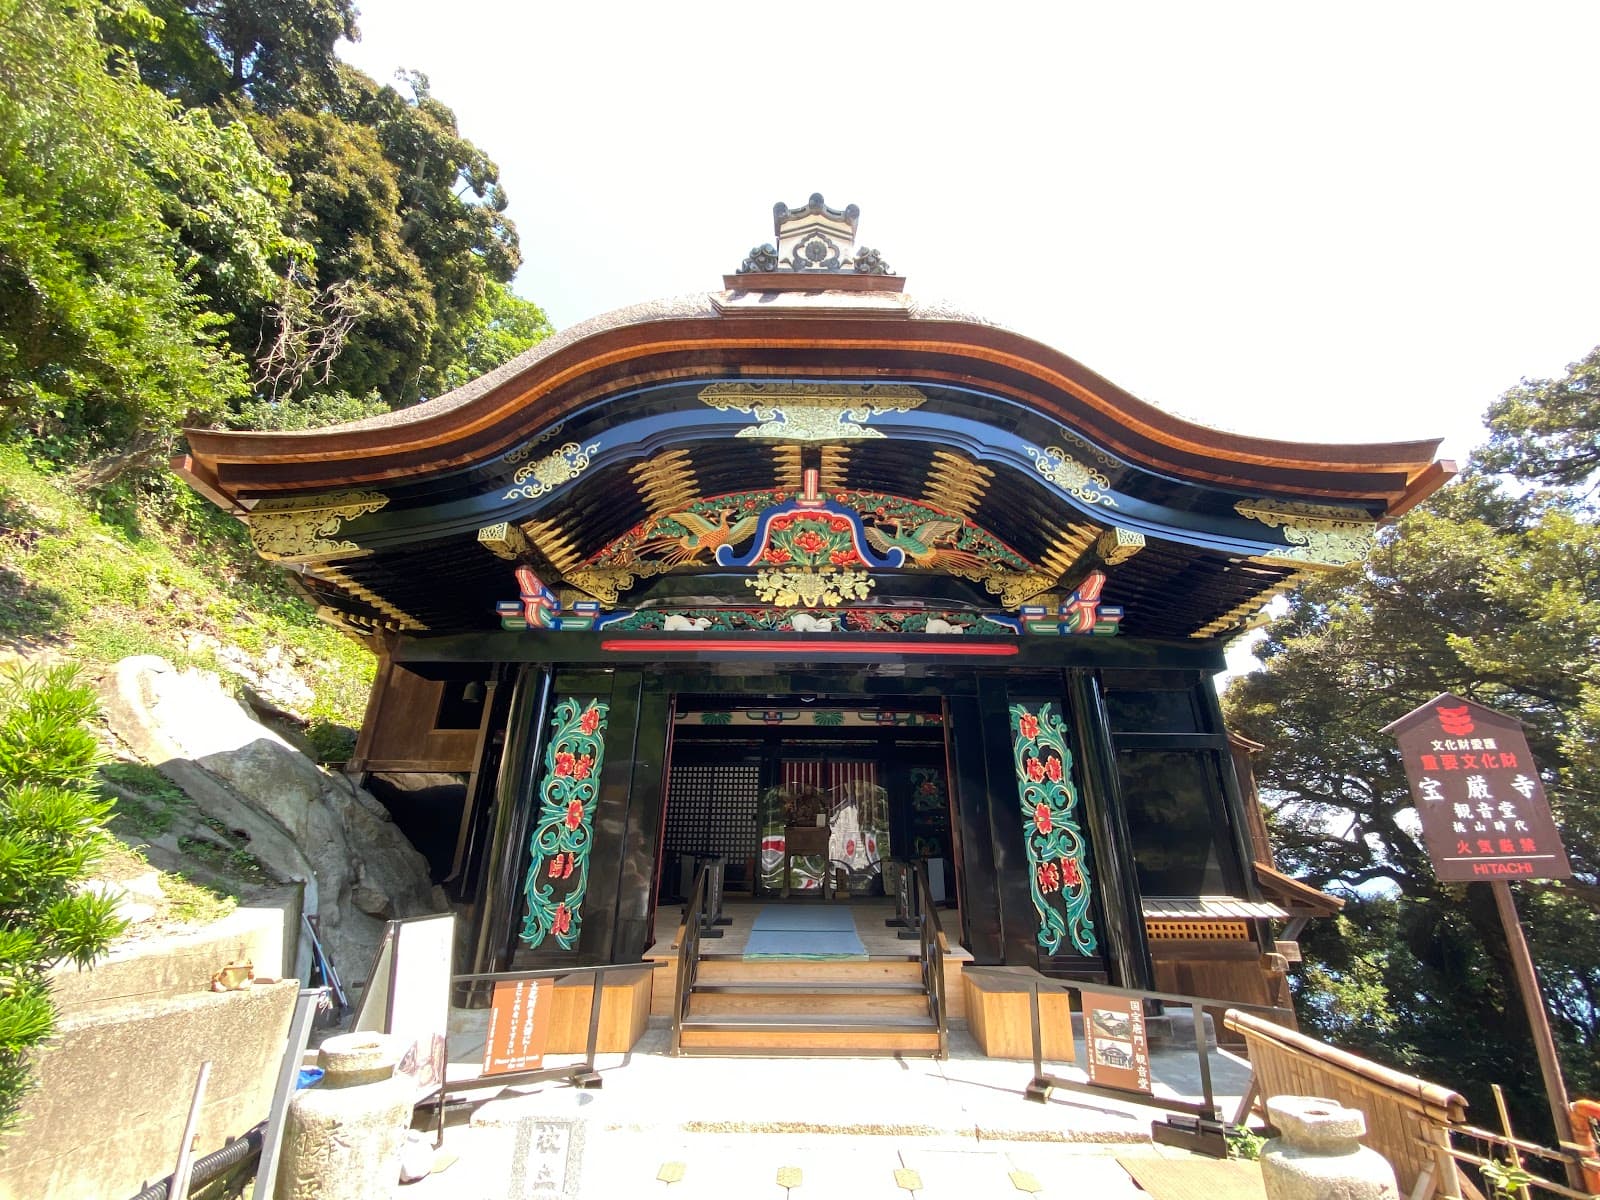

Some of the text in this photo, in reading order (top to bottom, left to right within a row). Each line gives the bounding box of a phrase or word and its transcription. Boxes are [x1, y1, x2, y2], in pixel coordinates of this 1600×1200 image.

[1431, 738, 1498, 751] 文化財愛護
[1420, 752, 1518, 770] 重要文化財
[1418, 774, 1536, 801] 宝厳寺
[1453, 801, 1517, 819] 観音堂
[1453, 820, 1529, 833] 桃山時代
[1457, 838, 1537, 854] 火気厳禁
[1473, 862, 1533, 875] HITACHI
